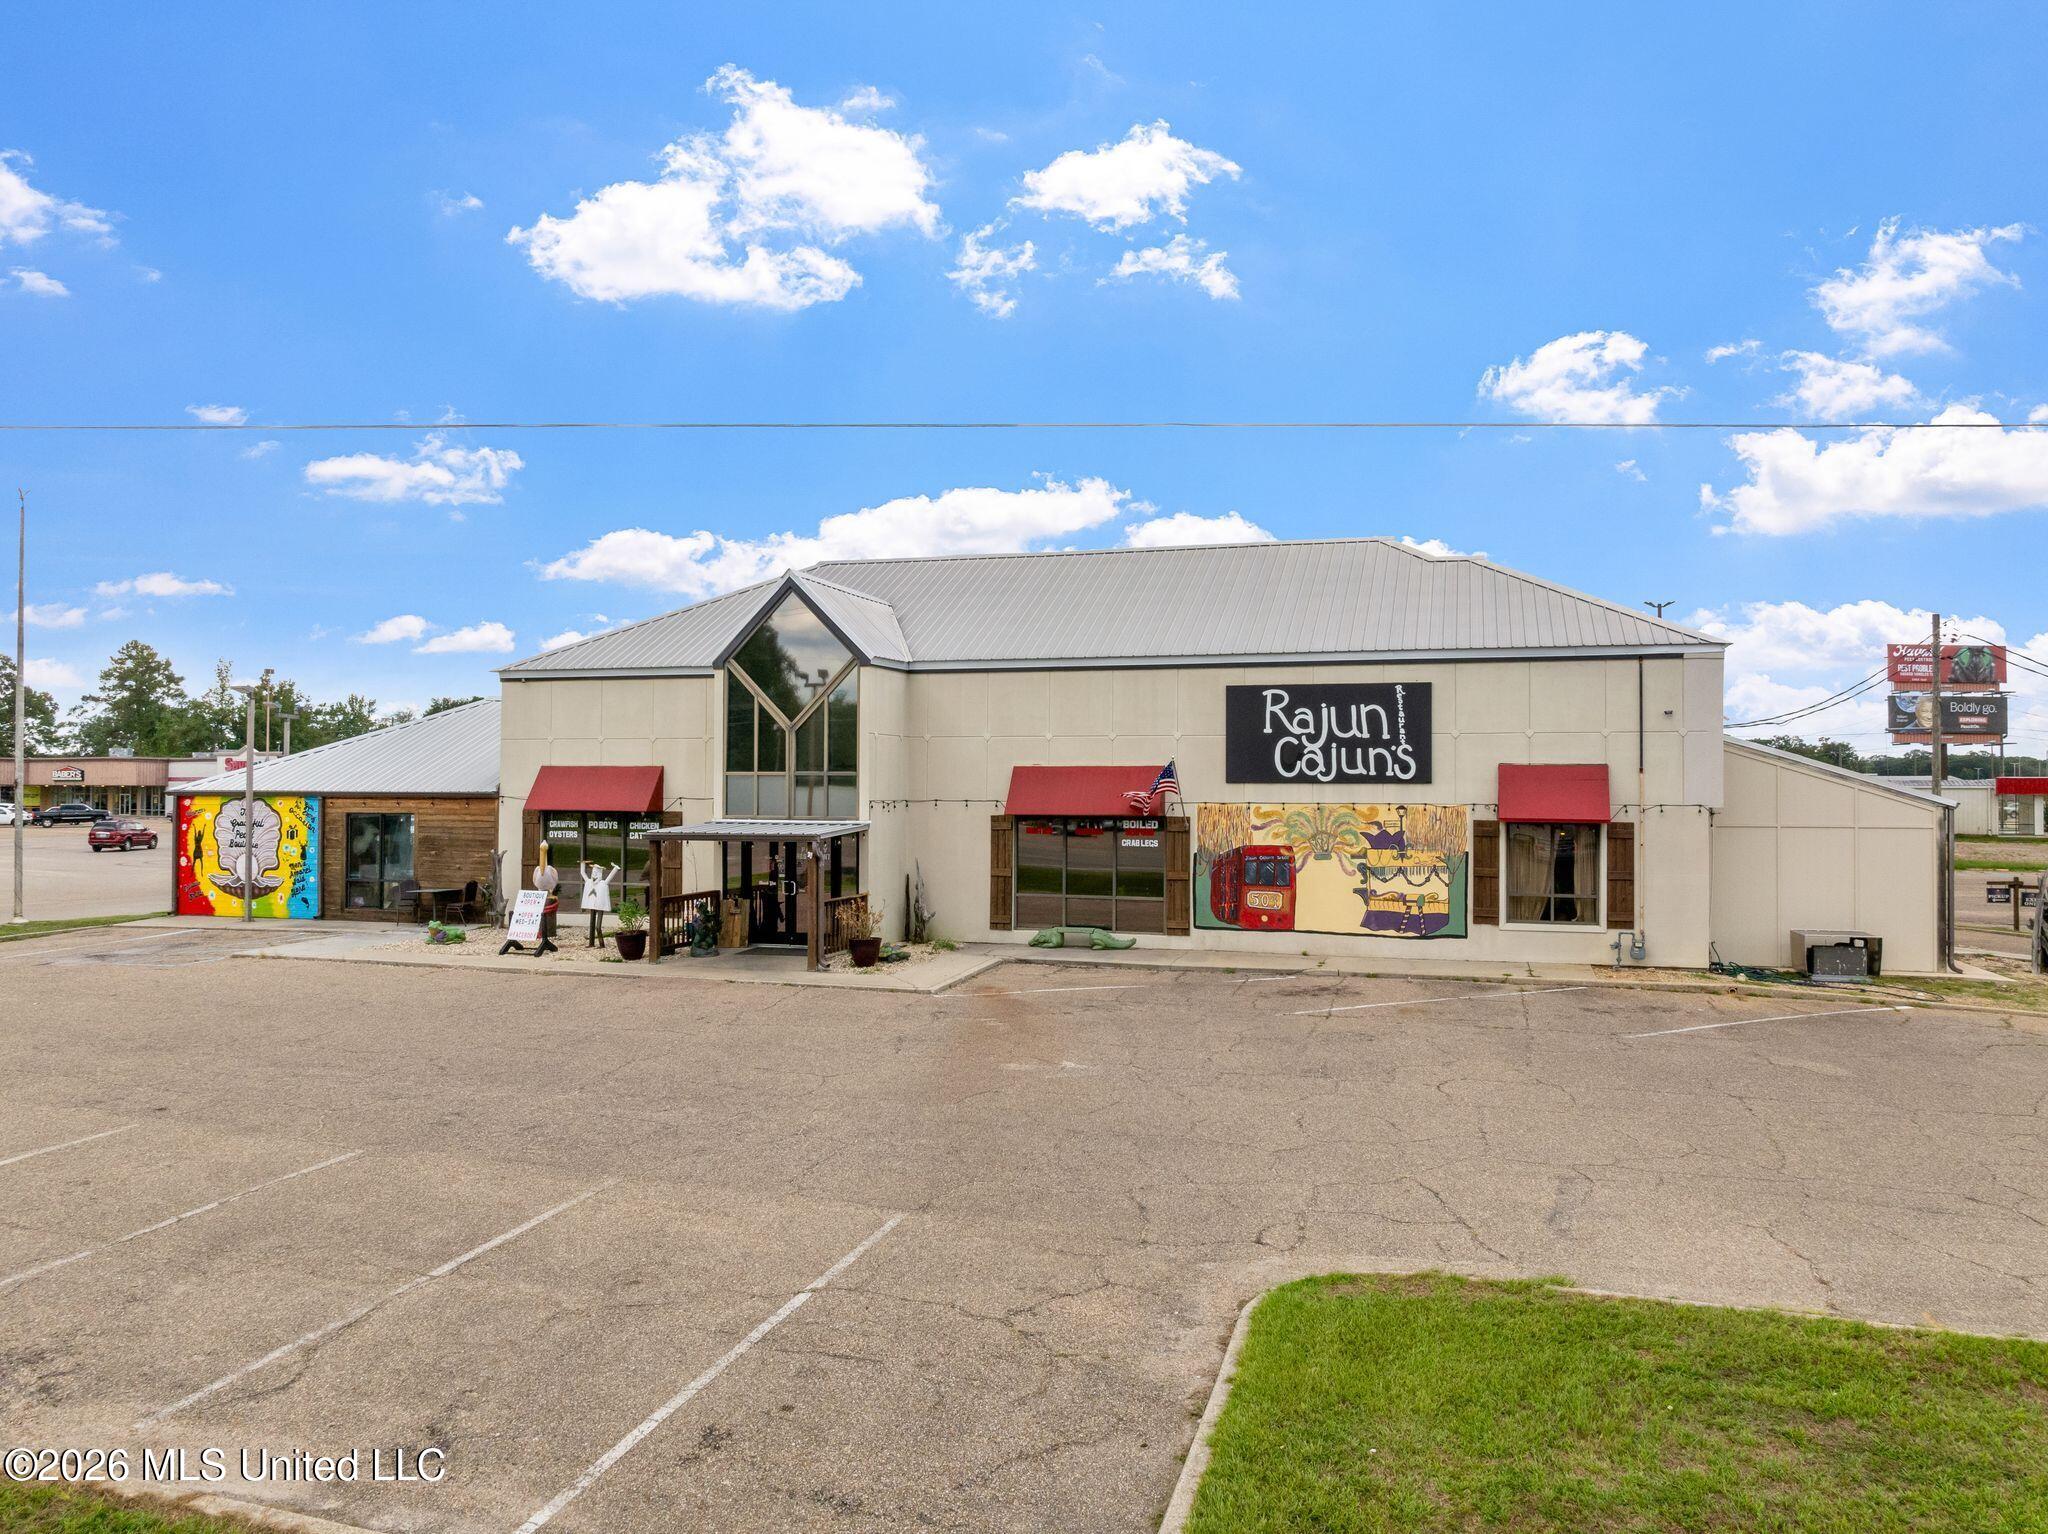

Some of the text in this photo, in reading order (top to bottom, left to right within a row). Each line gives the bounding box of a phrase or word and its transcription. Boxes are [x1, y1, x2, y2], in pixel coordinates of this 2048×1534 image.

[1950, 702, 1998, 714] Boldly go.
[1262, 688, 1391, 747] Rajun
[1394, 684, 1407, 746] Restaurant
[549, 820, 579, 828] CRAWFISH
[599, 821, 618, 829] BOYS
[629, 822, 660, 830] CHICKEN
[1122, 820, 1159, 829] BOILED
[549, 830, 578, 838] OYSTERS
[1121, 839, 1159, 847] CRAB LEGS
